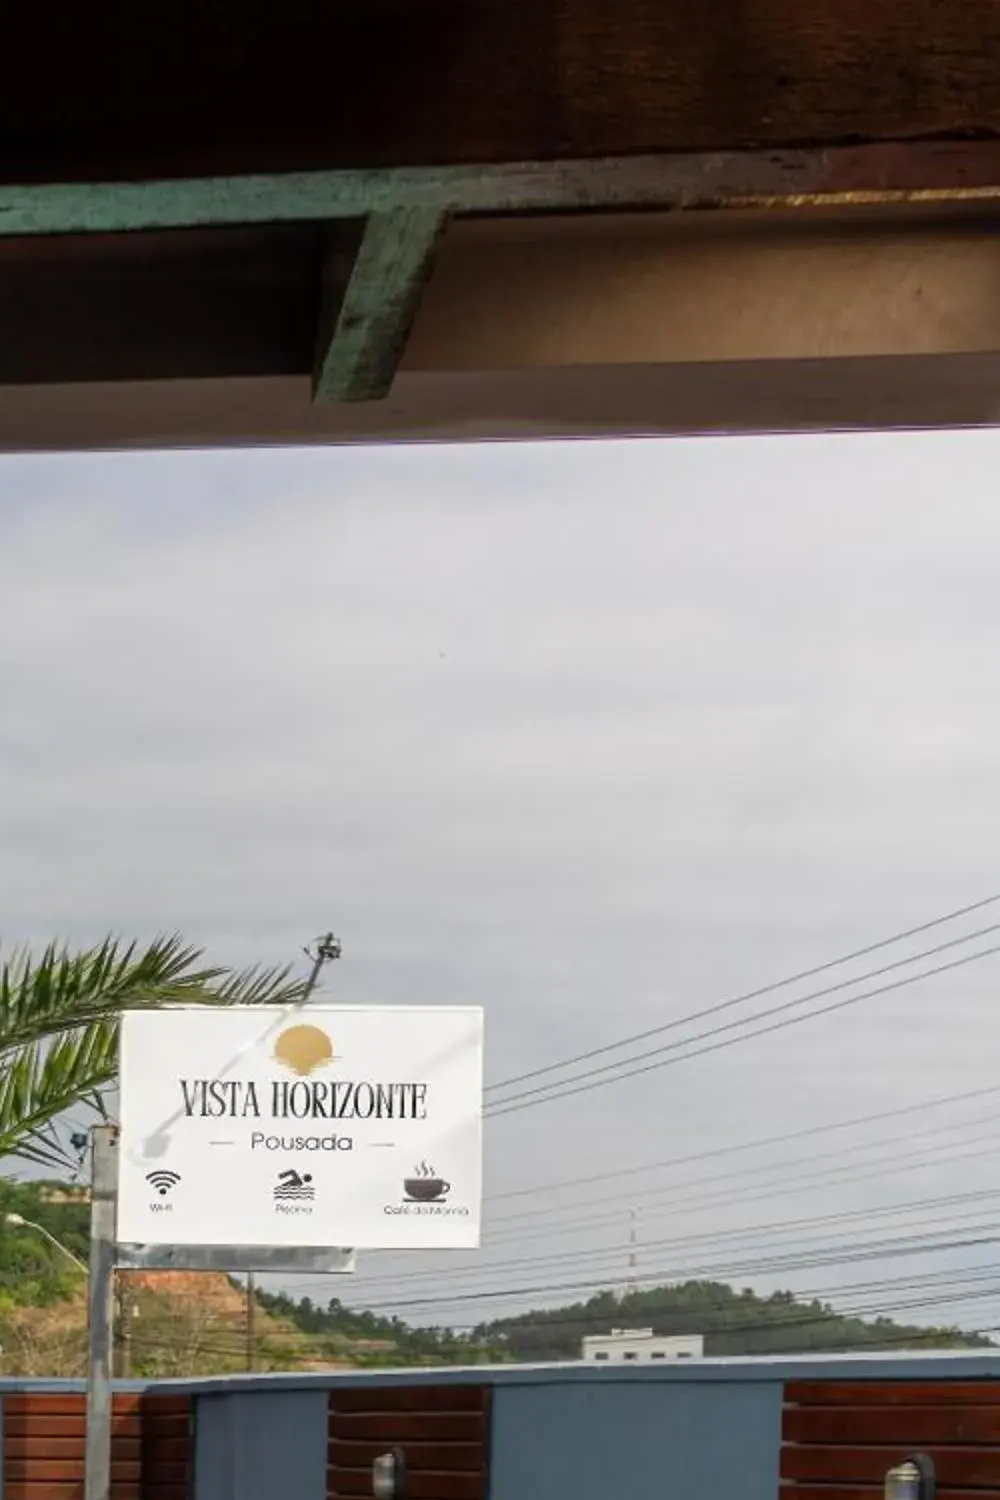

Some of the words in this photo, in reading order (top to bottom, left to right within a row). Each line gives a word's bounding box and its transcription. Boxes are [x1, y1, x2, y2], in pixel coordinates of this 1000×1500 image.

[179, 1079, 260, 1117] VISTA
[271, 1080, 428, 1119] HORIZONTE
[251, 1132, 353, 1151] Pousada
